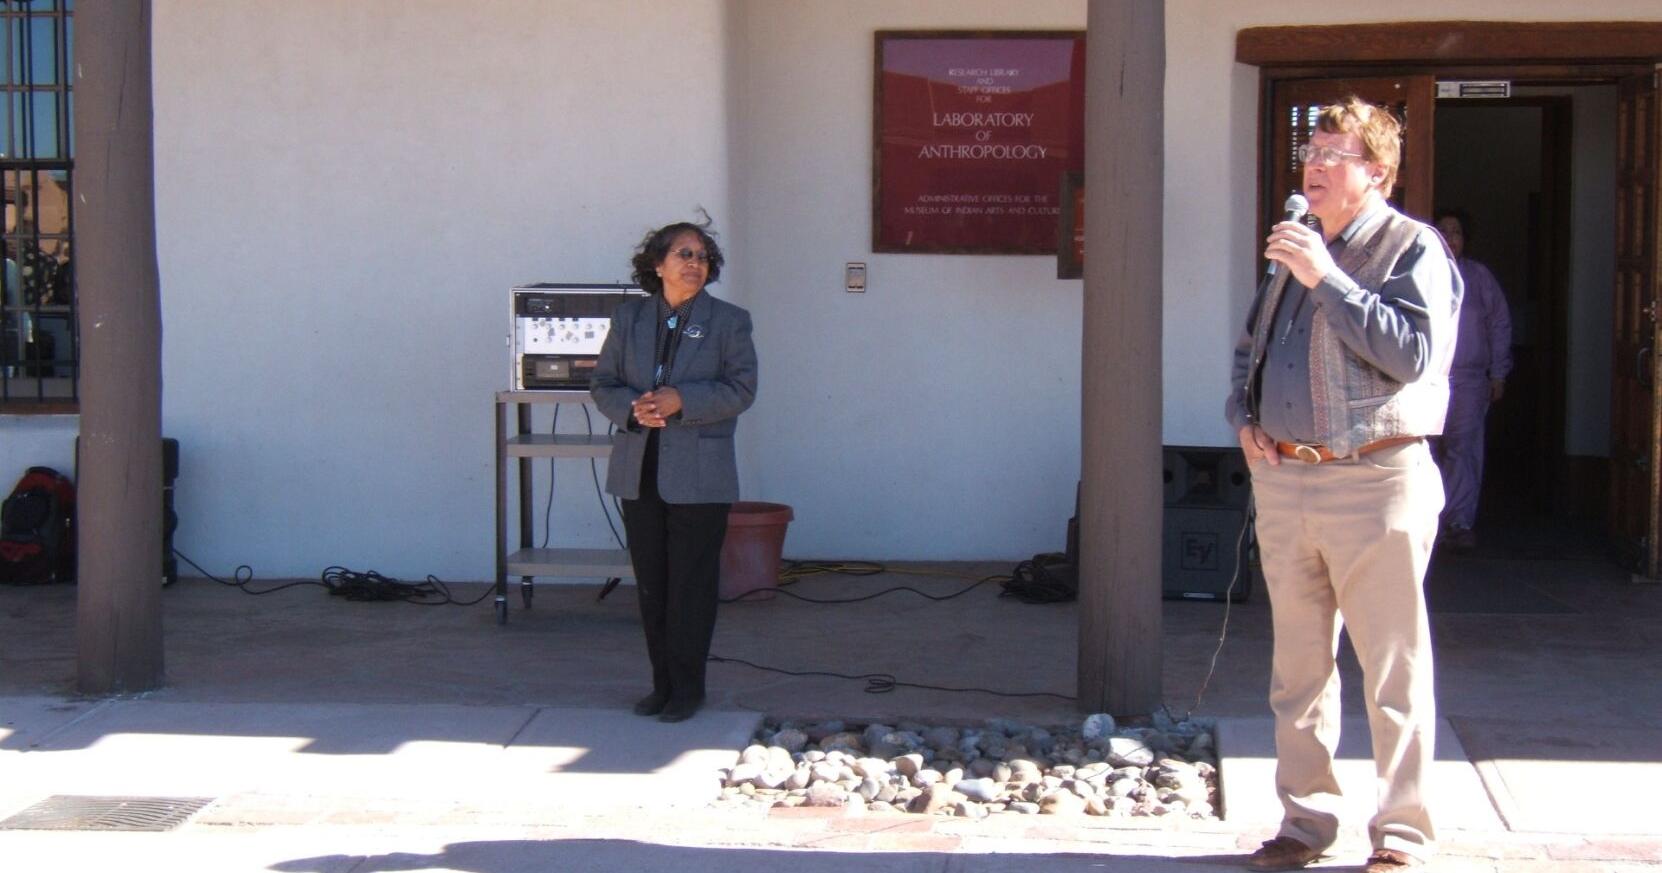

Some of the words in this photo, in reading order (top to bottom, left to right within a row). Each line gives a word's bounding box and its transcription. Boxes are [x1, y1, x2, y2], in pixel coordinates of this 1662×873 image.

[948, 68, 987, 77] RESEARCH
[989, 68, 1019, 77] LIBRARY
[976, 77, 994, 86] AND
[976, 95, 992, 104] FOR
[933, 112, 1034, 127] LABORATORY
[975, 130, 992, 142] OF
[918, 145, 1047, 159] ANTHROPOLOGY
[918, 194, 979, 203] ADMINISTRATIVE
[982, 194, 1012, 204] OFFICES
[1014, 194, 1031, 204] FOR
[1034, 194, 1048, 204] THE
[904, 206, 939, 215] MUSEUM
[941, 206, 953, 216] OF
[955, 206, 983, 216] INDIAN
[984, 206, 1005, 216] ARTS
[1008, 206, 1026, 216] AND
